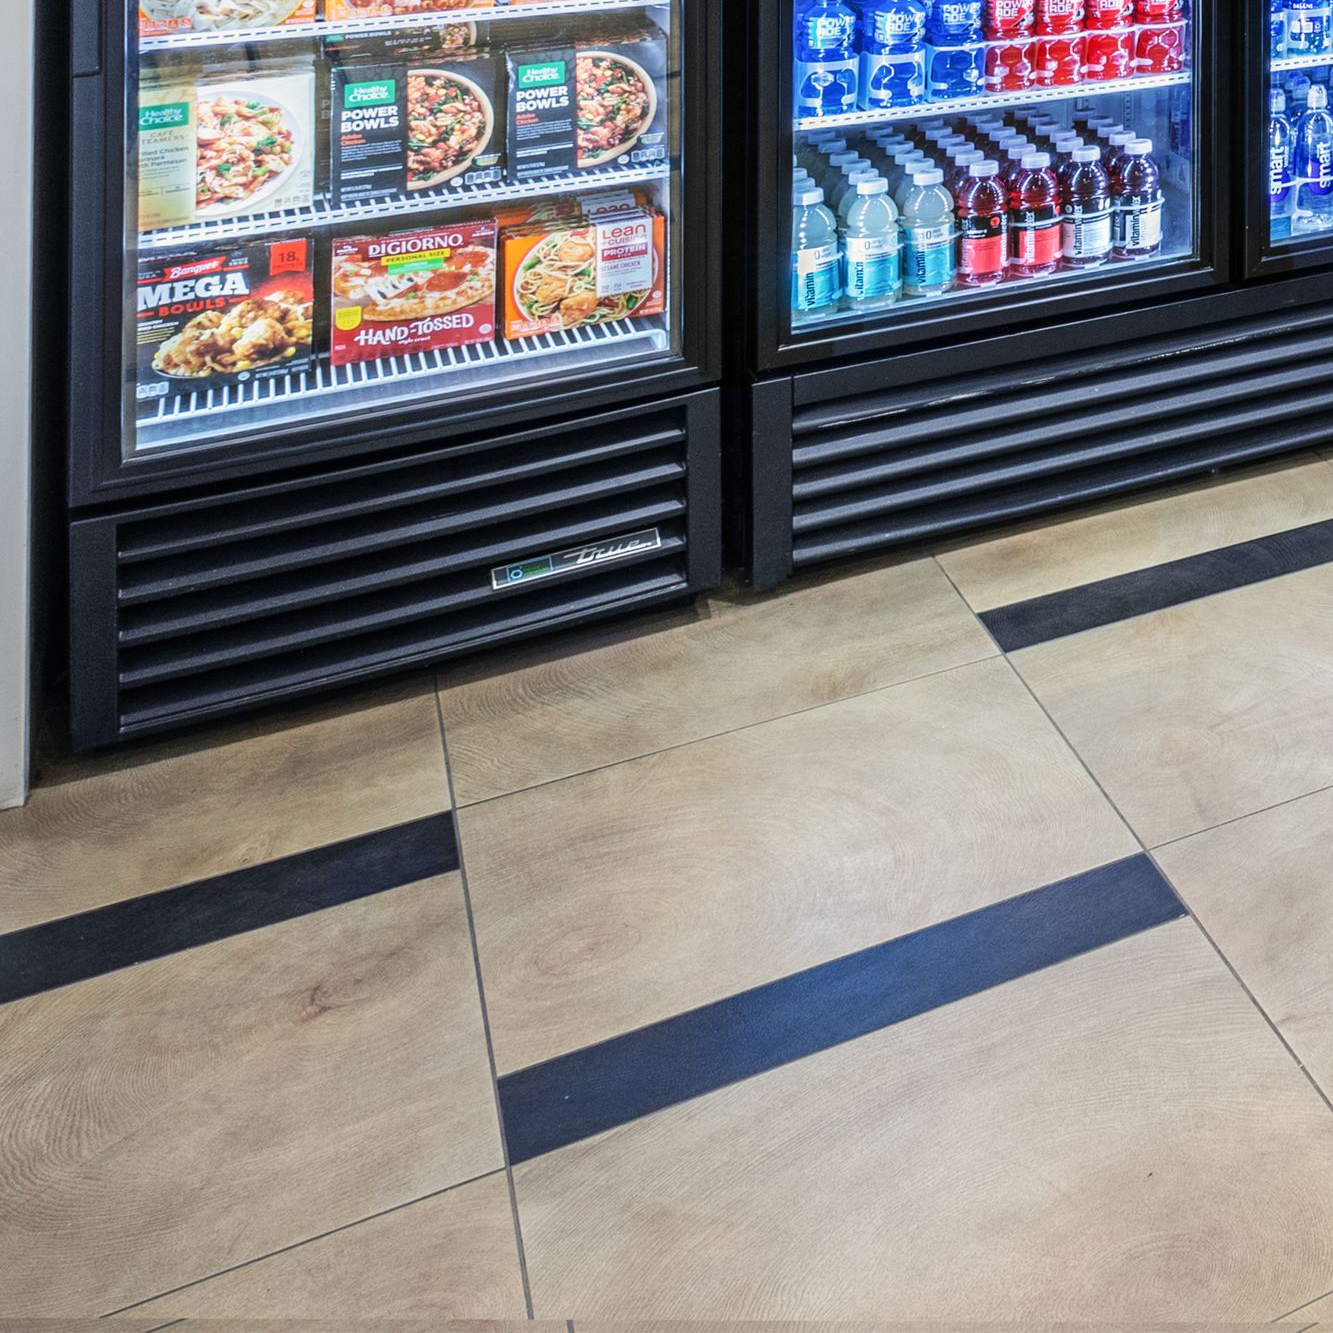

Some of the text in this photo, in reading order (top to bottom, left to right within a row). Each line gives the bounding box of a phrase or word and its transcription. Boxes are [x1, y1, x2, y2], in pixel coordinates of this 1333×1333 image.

[522, 73, 560, 83] Choice
[527, 67, 558, 77] Healthy
[349, 91, 390, 102] Choice
[354, 86, 388, 96] Healthy
[516, 86, 568, 101] POWER
[516, 97, 569, 112] BOWLS
[140, 114, 183, 125] Choice
[144, 107, 183, 118] Healthy
[341, 106, 398, 120] POWER
[341, 117, 399, 132] BOWLS
[1270, 147, 1282, 196] smart
[1319, 142, 1331, 189] smart
[603, 224, 646, 240] Lean
[603, 244, 646, 257] PROTEIN
[386, 254, 427, 263] PERSONAL
[170, 260, 220, 278] Banquet
[137, 272, 249, 311] MEGA
[158, 298, 226, 317] BOWLS
[354, 314, 474, 346] HAND-TOSSED
